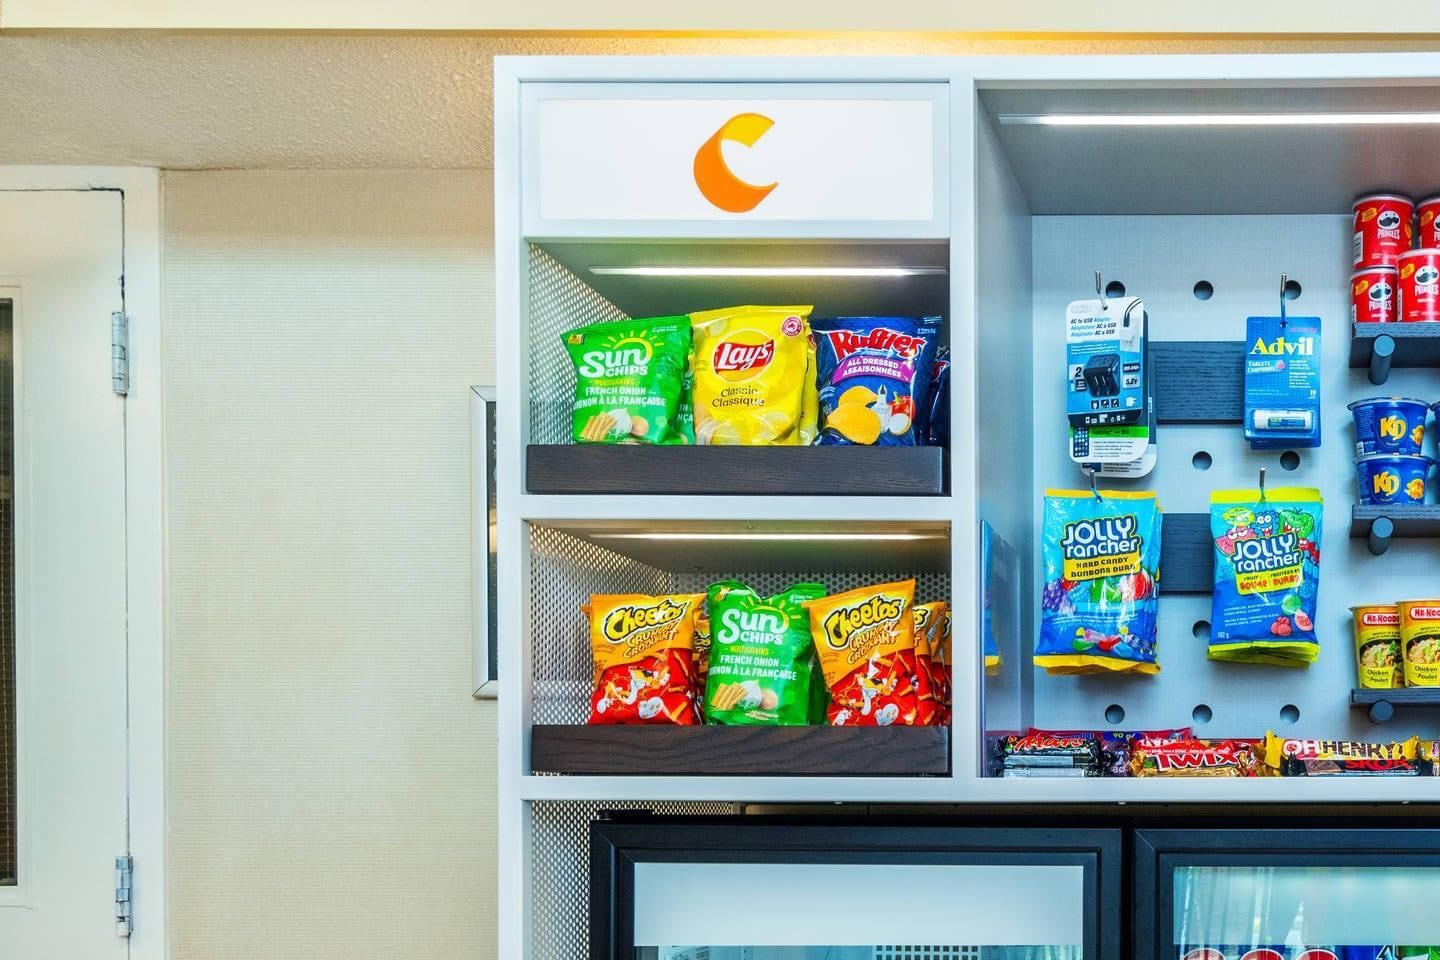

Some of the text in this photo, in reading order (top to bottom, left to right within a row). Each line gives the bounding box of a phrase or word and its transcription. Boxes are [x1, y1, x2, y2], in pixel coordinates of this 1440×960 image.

[828, 328, 927, 363] Ruffles
[1249, 337, 1314, 355] Advil
[579, 348, 651, 378] Sun
[716, 341, 773, 371] Lay's
[847, 358, 900, 370] ALL DRESSED
[605, 365, 648, 377] CHIPS
[1074, 366, 1082, 378] 2
[585, 387, 646, 396] FRENCH ONION
[606, 397, 618, 405] LA
[1380, 414, 1407, 441] KD
[1373, 471, 1400, 497] KD
[1062, 518, 1133, 546] JOLLY
[1066, 538, 1138, 558] rancher
[1234, 534, 1294, 561] JOLLY
[1076, 556, 1129, 569] HARD CANDY
[1237, 552, 1299, 572] rancher
[1071, 567, 1111, 578] BONBONS
[602, 599, 691, 643] Cheetos
[718, 608, 788, 644] Sun
[823, 597, 903, 650] Cheetos
[740, 631, 784, 645] CHIPS
[720, 655, 779, 667] FRENCH ONION
[740, 667, 751, 675] LA
[1414, 665, 1438, 673] Chicken
[1283, 740, 1405, 760] OH HENRY!
[1155, 750, 1240, 772] TWIX
[1345, 757, 1411, 771] SKOR
